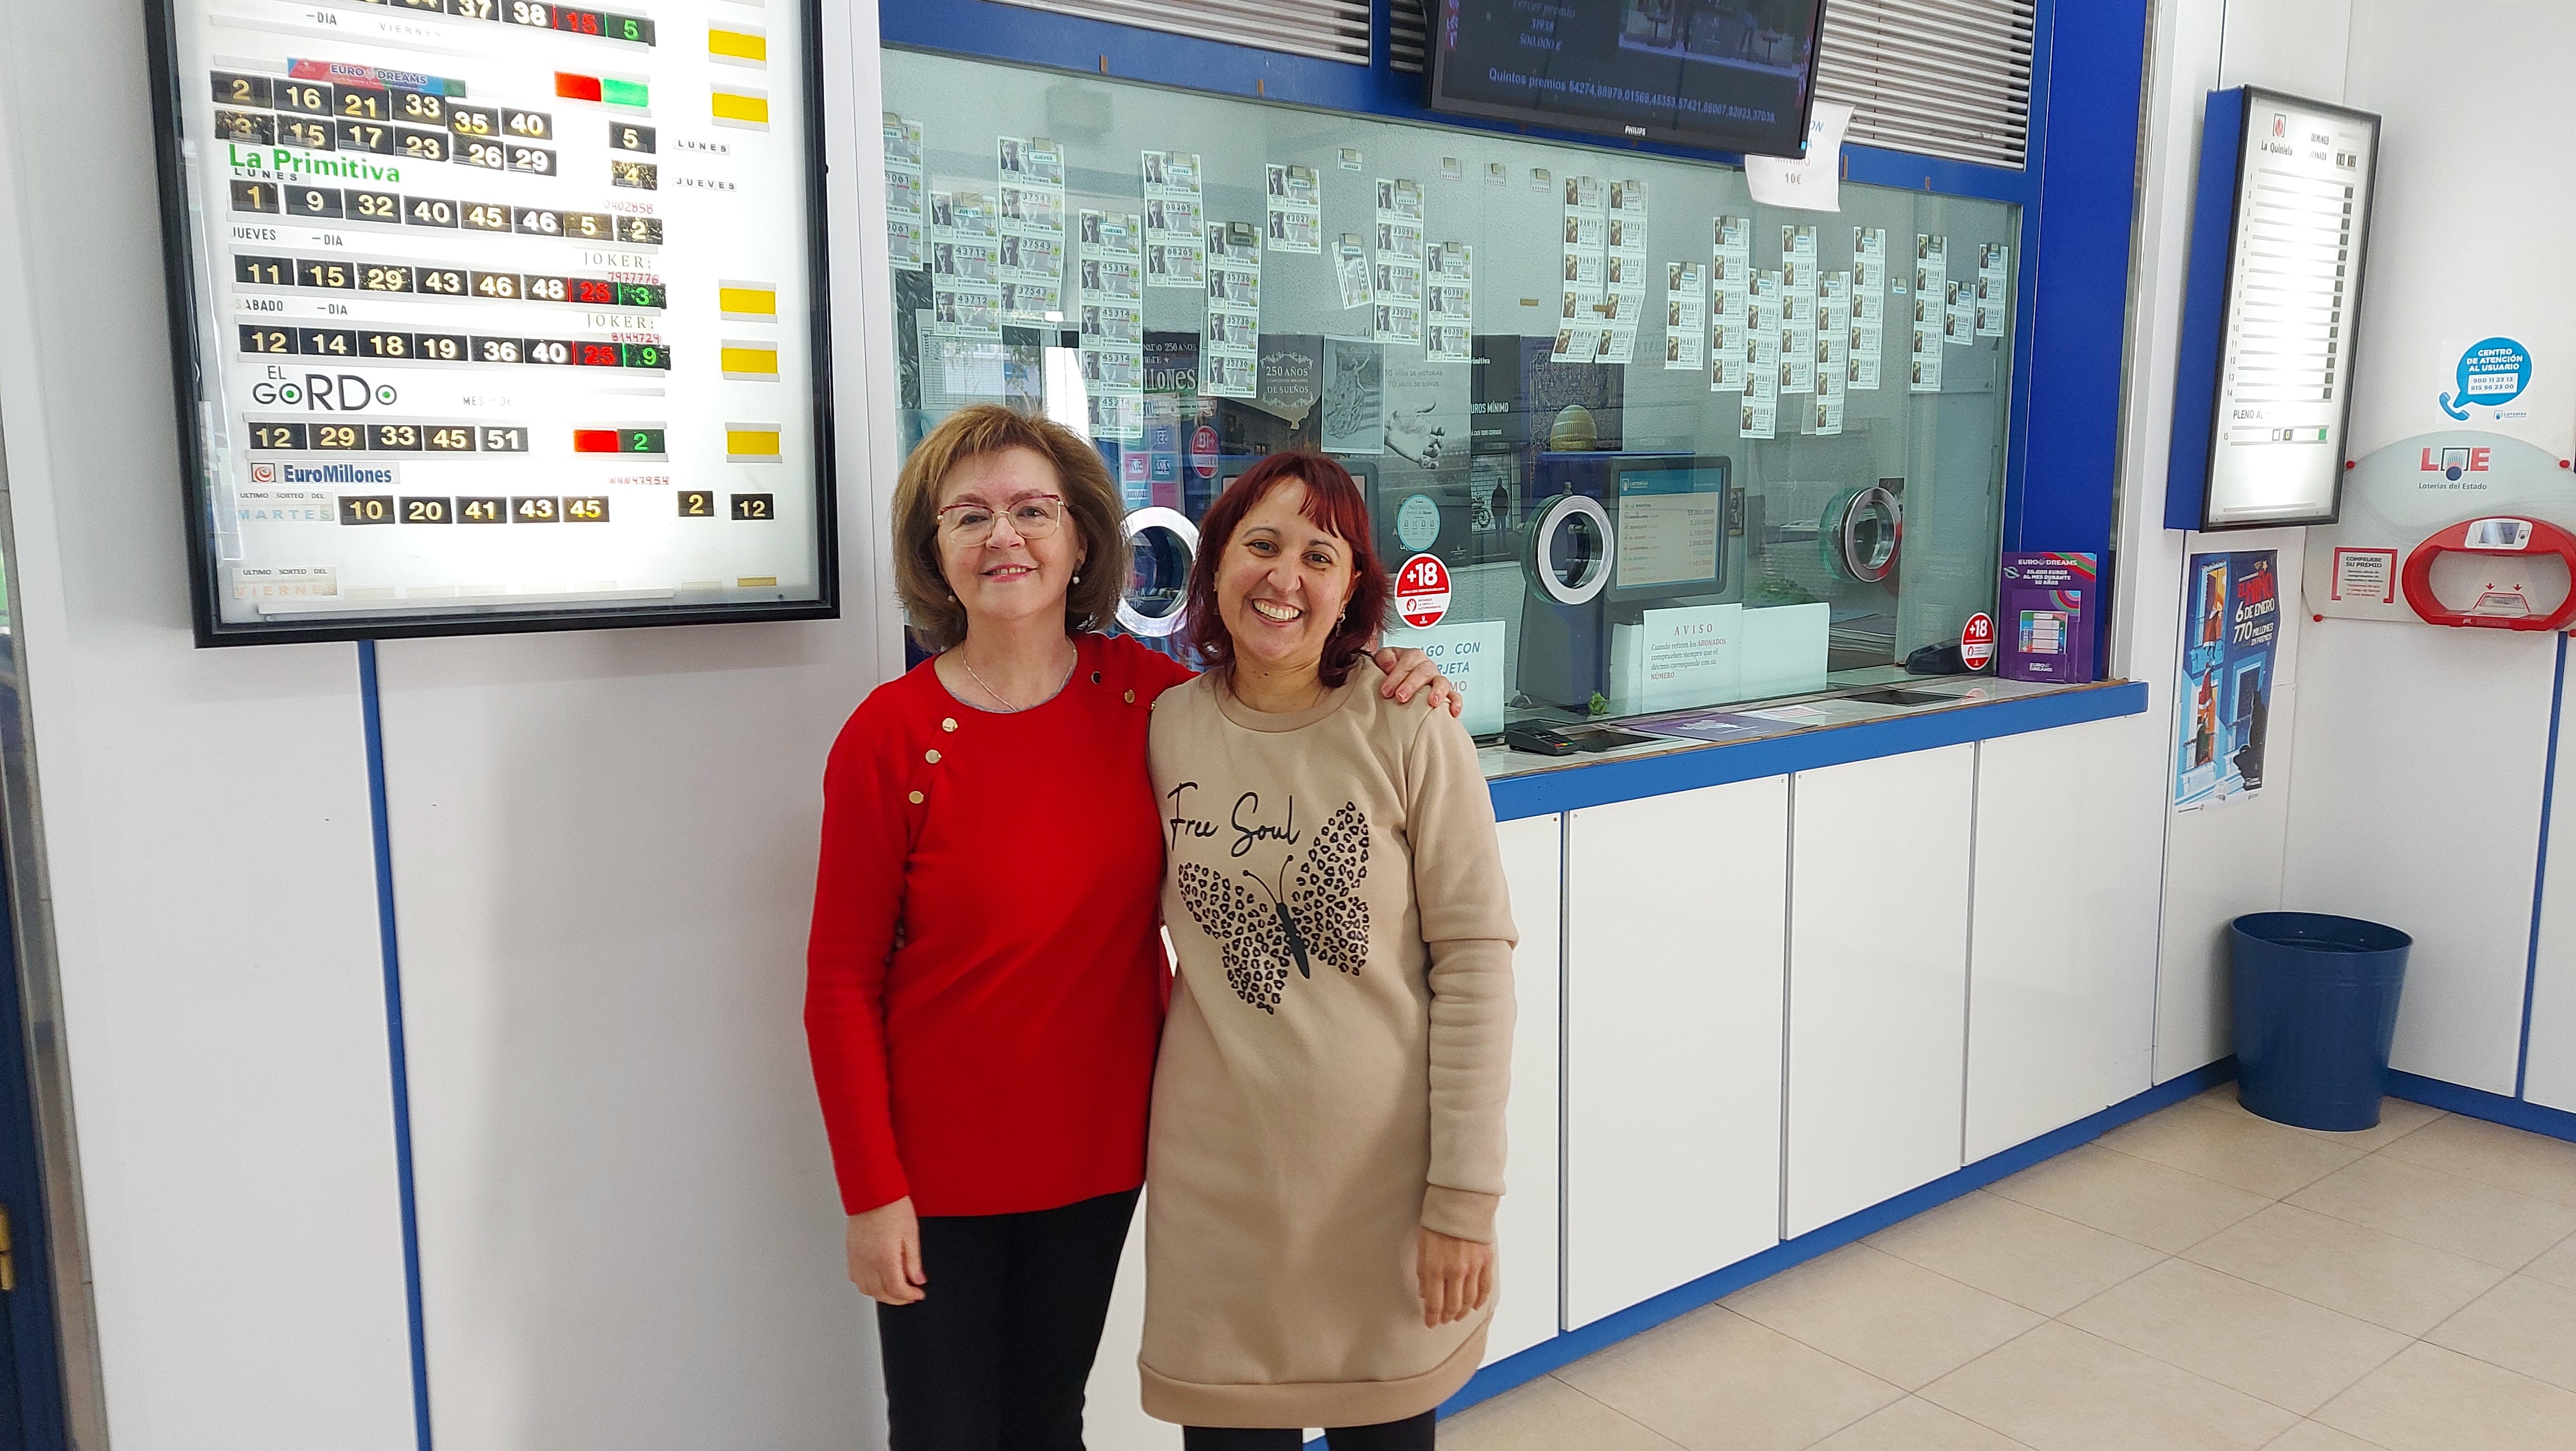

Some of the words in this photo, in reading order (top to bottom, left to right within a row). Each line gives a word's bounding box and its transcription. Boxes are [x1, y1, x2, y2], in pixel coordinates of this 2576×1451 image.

[514, 2, 547, 26] 38
[567, 12, 597, 34] 15
[623, 20, 638, 38] 5
[330, 65, 364, 76] EURO
[378, 71, 427, 84] DREAMS
[1489, 67, 1526, 84] Quintos
[1529, 76, 1565, 91] premios
[232, 79, 251, 100] 2
[287, 86, 321, 109] 16
[345, 94, 375, 117] 21
[405, 93, 440, 118] 33
[454, 111, 488, 134] 35
[510, 113, 543, 135] 40
[1624, 125, 1646, 136] PHILIPS
[623, 128, 638, 148] 5
[290, 123, 325, 147] 15
[349, 125, 382, 149] 17
[406, 136, 440, 158] 23
[469, 143, 501, 167] 26
[515, 149, 549, 171] 29
[2261, 140, 2267, 151] La
[2270, 143, 2292, 156] Quiniela
[2311, 133, 2329, 145] DOMINGO
[229, 144, 262, 168] La
[274, 148, 400, 183] Primitiva
[234, 168, 297, 182] LUNES
[1785, 173, 1802, 184] 10€
[2251, 173, 2252, 182] 1
[676, 177, 735, 191] JUEVES
[1023, 192, 1051, 203] 37543
[2248, 191, 2252, 199] 2
[247, 186, 260, 209] 1
[306, 191, 324, 211] 9
[358, 194, 392, 216] 32
[414, 201, 450, 223] 40
[469, 206, 502, 228] 45
[523, 211, 557, 231] 46
[580, 216, 596, 235] 5
[2247, 208, 2250, 217] 3
[957, 246, 986, 255] 43712
[1102, 262, 1129, 272] 45314
[247, 263, 280, 284] 11
[310, 265, 344, 287] 15
[368, 268, 402, 290] 29
[425, 272, 460, 293] 43
[480, 275, 512, 298] 46
[532, 279, 564, 299] 48
[579, 281, 611, 302] 25
[635, 287, 650, 305] 3
[2240, 274, 2244, 283] 7
[2238, 290, 2242, 299] 8
[2237, 308, 2241, 316] 9
[2233, 324, 2240, 333] 10
[251, 332, 287, 353] 12
[313, 334, 347, 354] 14
[370, 335, 404, 356] 18
[423, 338, 456, 358] 19
[484, 340, 516, 362] 36
[532, 341, 565, 362] 40
[584, 345, 614, 366] 25
[643, 347, 657, 366] 9
[2232, 340, 2237, 348] 11
[2230, 357, 2236, 365] 12
[2480, 355, 2523, 363] ATENCIÓN
[267, 366, 287, 380] EL
[1266, 366, 1282, 376] 250
[1284, 367, 1308, 376] AÑOS
[2228, 373, 2235, 382] 13
[1280, 384, 1309, 393] SUEÑOS
[2227, 389, 2233, 397] 14
[1471, 403, 1486, 413] UROS
[1487, 400, 1509, 413] MÍNIMO
[2233, 410, 2254, 420] PLENO
[256, 427, 291, 448] 12
[320, 426, 355, 446] 29
[380, 426, 415, 445] 33
[433, 429, 466, 449] 45
[487, 430, 519, 450] 51
[633, 433, 648, 451] 2
[284, 464, 392, 483] EuroMillones
[350, 500, 383, 520] 10
[409, 501, 442, 520] 20
[465, 501, 496, 520] 41
[519, 500, 553, 518] 43
[570, 500, 601, 518] 45
[689, 494, 704, 514] 2
[739, 500, 766, 518] 12
[1407, 562, 1437, 587] +18
[2235, 601, 2244, 623] 6
[2245, 605, 2254, 620] DE
[2254, 597, 2275, 618] ENERO
[1674, 624, 1713, 635] AVISO
[1969, 619, 1988, 637] +18
[2233, 621, 2253, 644] 770
[2252, 622, 2274, 637] MILLONES
[1697, 638, 1726, 646] ABONADOS
[1455, 642, 1480, 654] CON
[1651, 652, 1682, 661] comprueben
[1670, 660, 1700, 669] corresponde
[1167, 781, 1219, 851] Free
[1231, 791, 1301, 858] Soul
